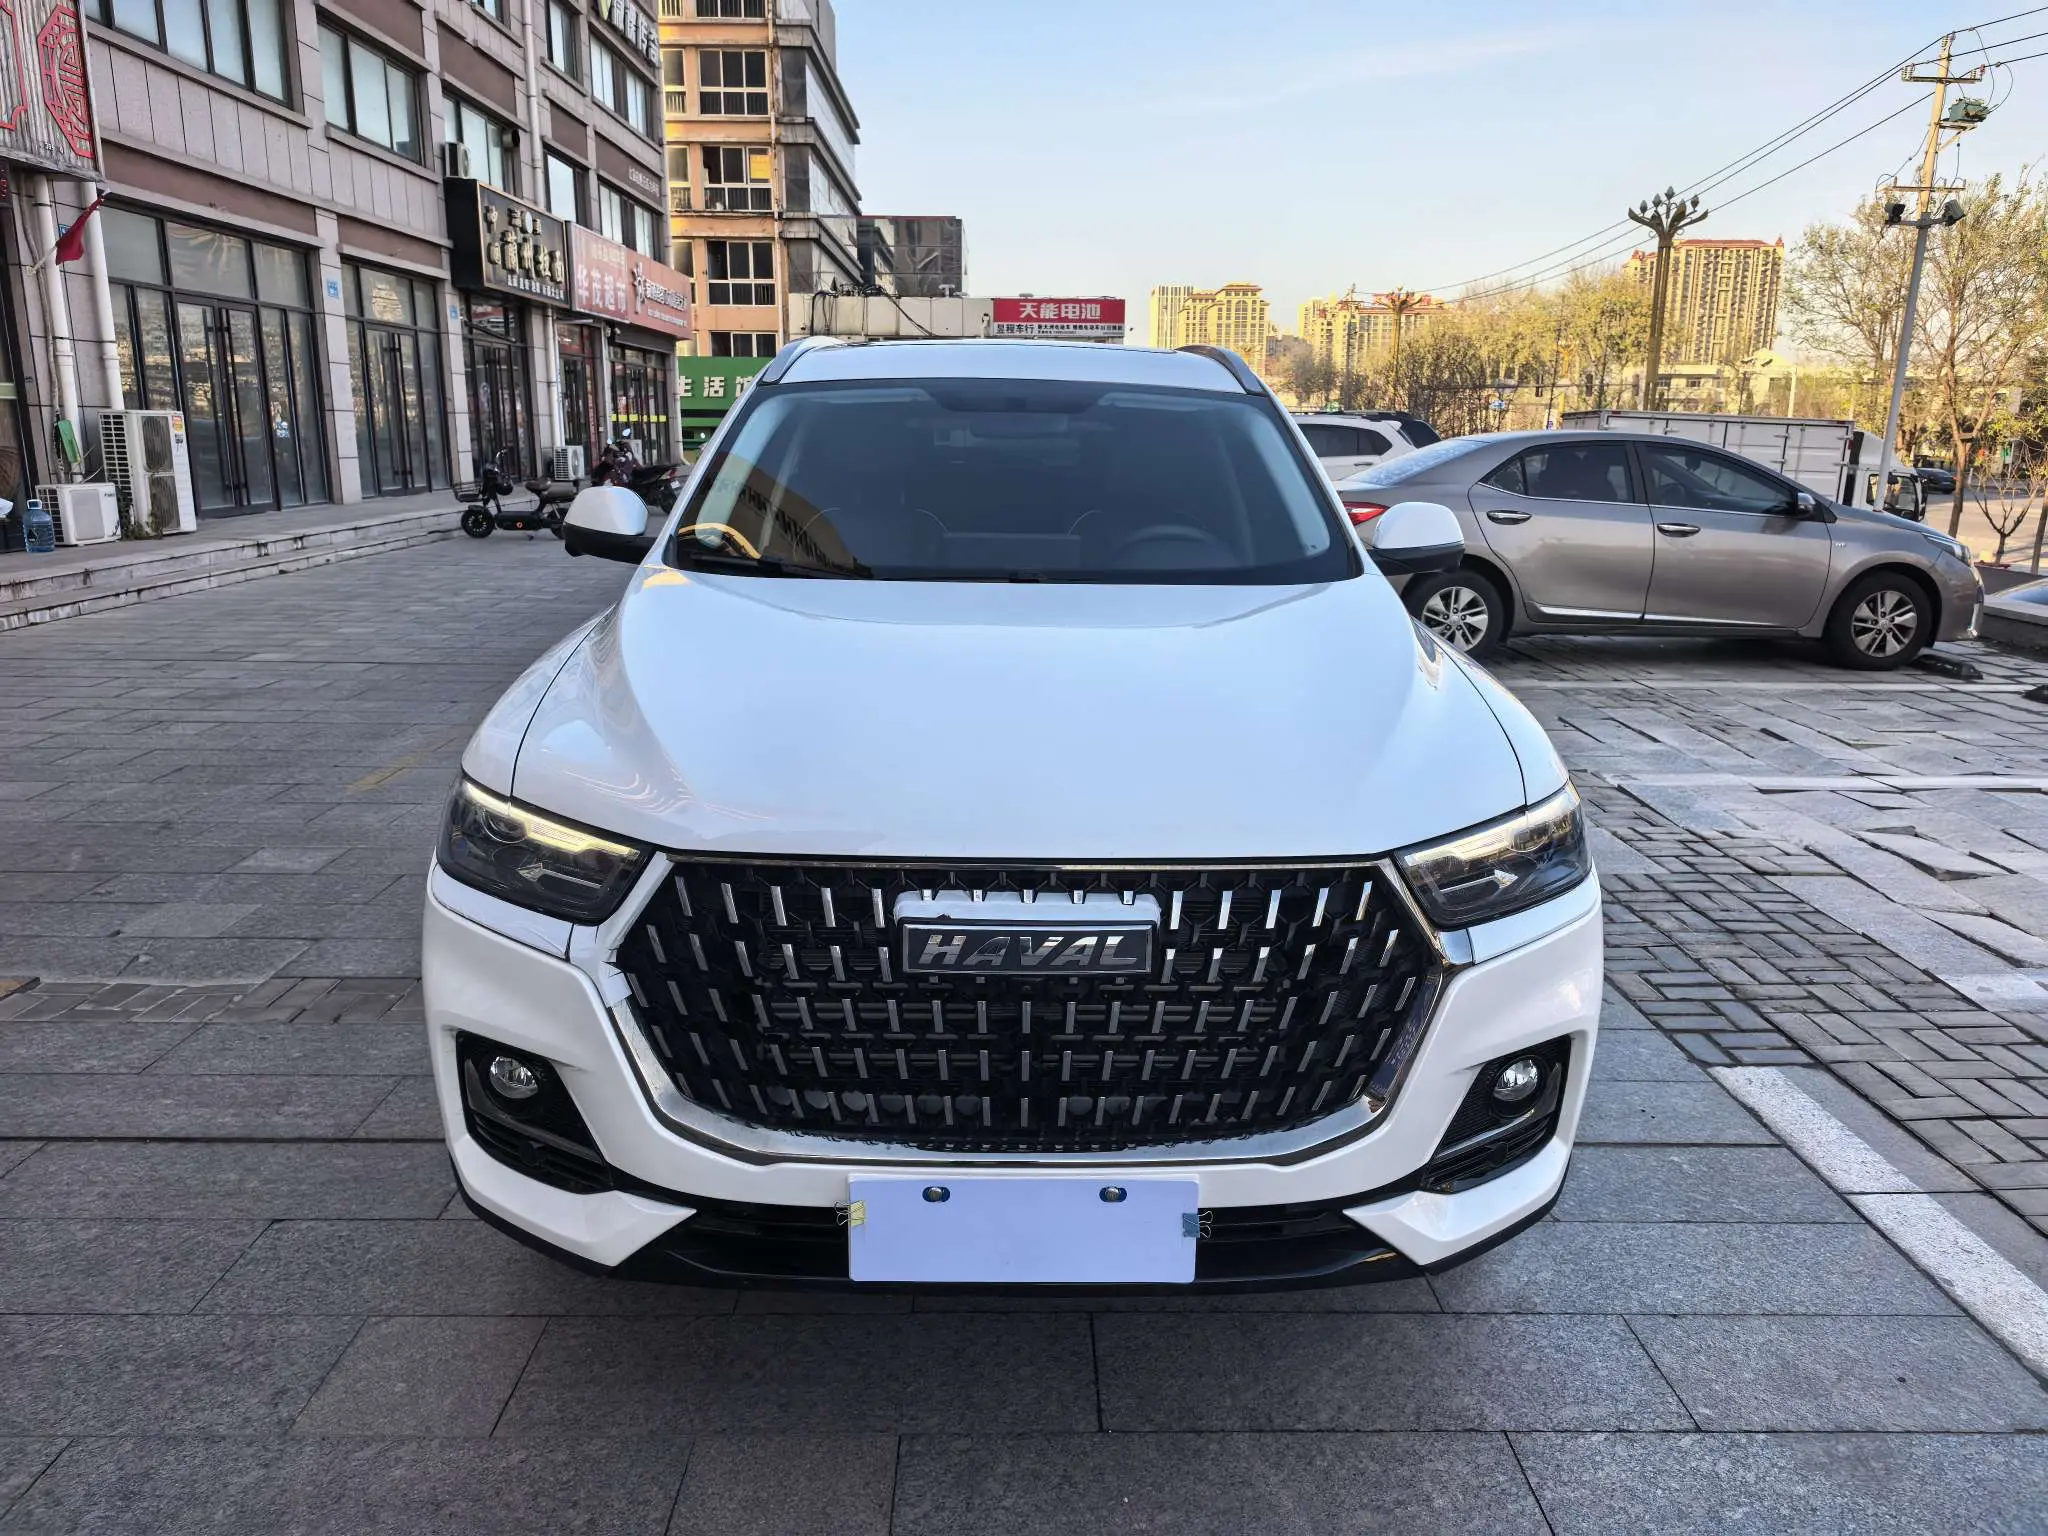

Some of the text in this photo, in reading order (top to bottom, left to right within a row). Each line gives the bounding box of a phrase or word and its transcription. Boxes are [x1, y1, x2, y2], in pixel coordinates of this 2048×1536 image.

[1019, 302, 1101, 319] 天能电池
[918, 935, 1138, 966] HAVAL
